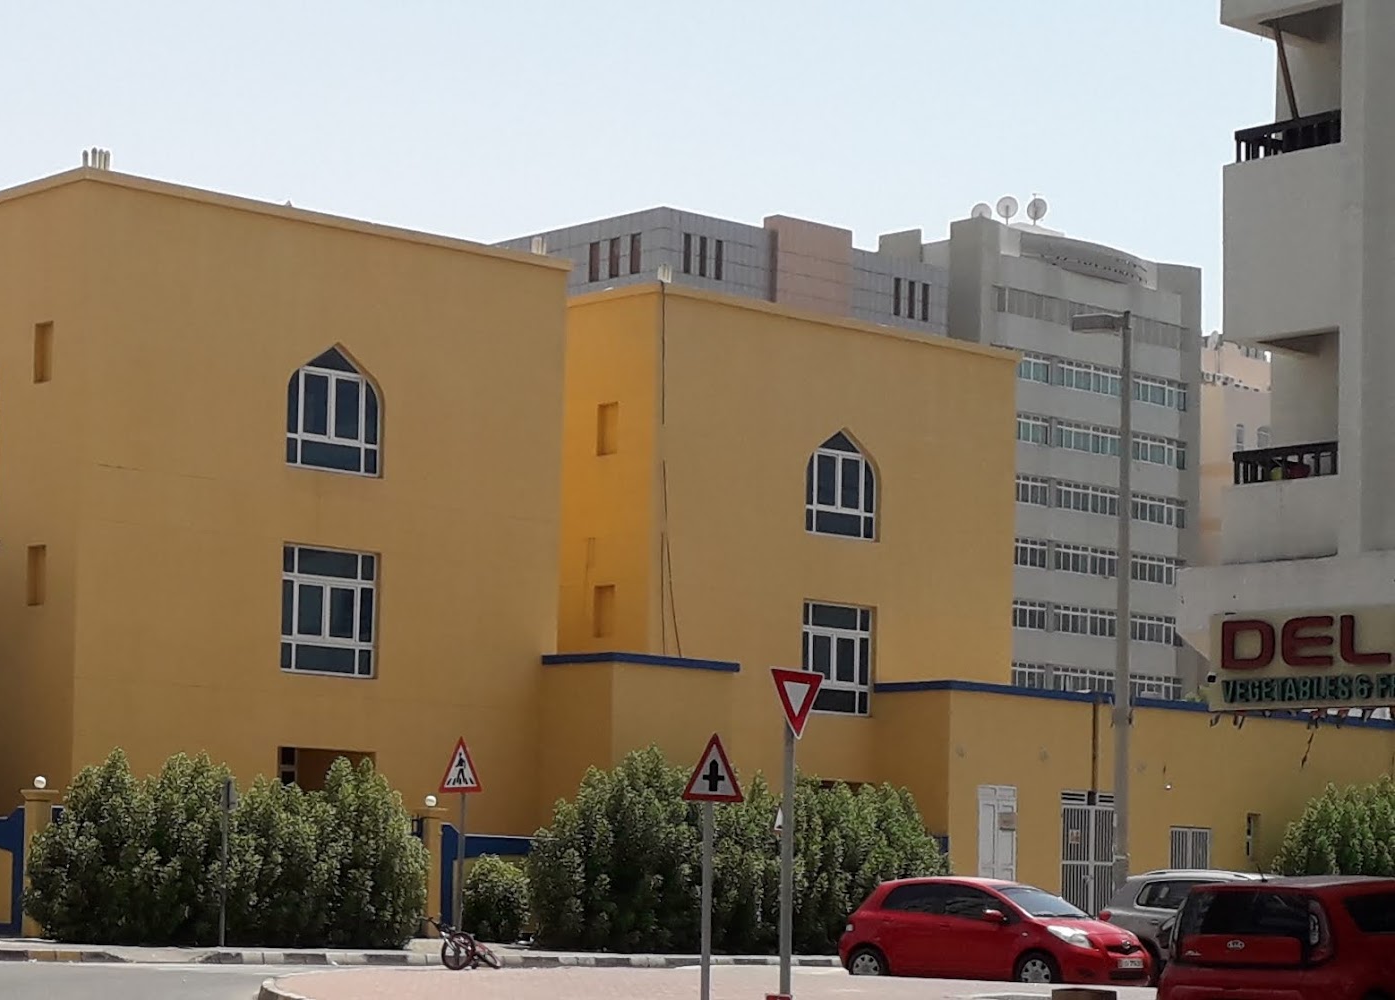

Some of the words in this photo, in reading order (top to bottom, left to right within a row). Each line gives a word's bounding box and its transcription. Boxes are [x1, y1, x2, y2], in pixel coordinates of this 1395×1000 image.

[1221, 614, 1392, 670] DEL
[1221, 674, 1352, 703] VEGETABLES
[1353, 673, 1373, 699] &
